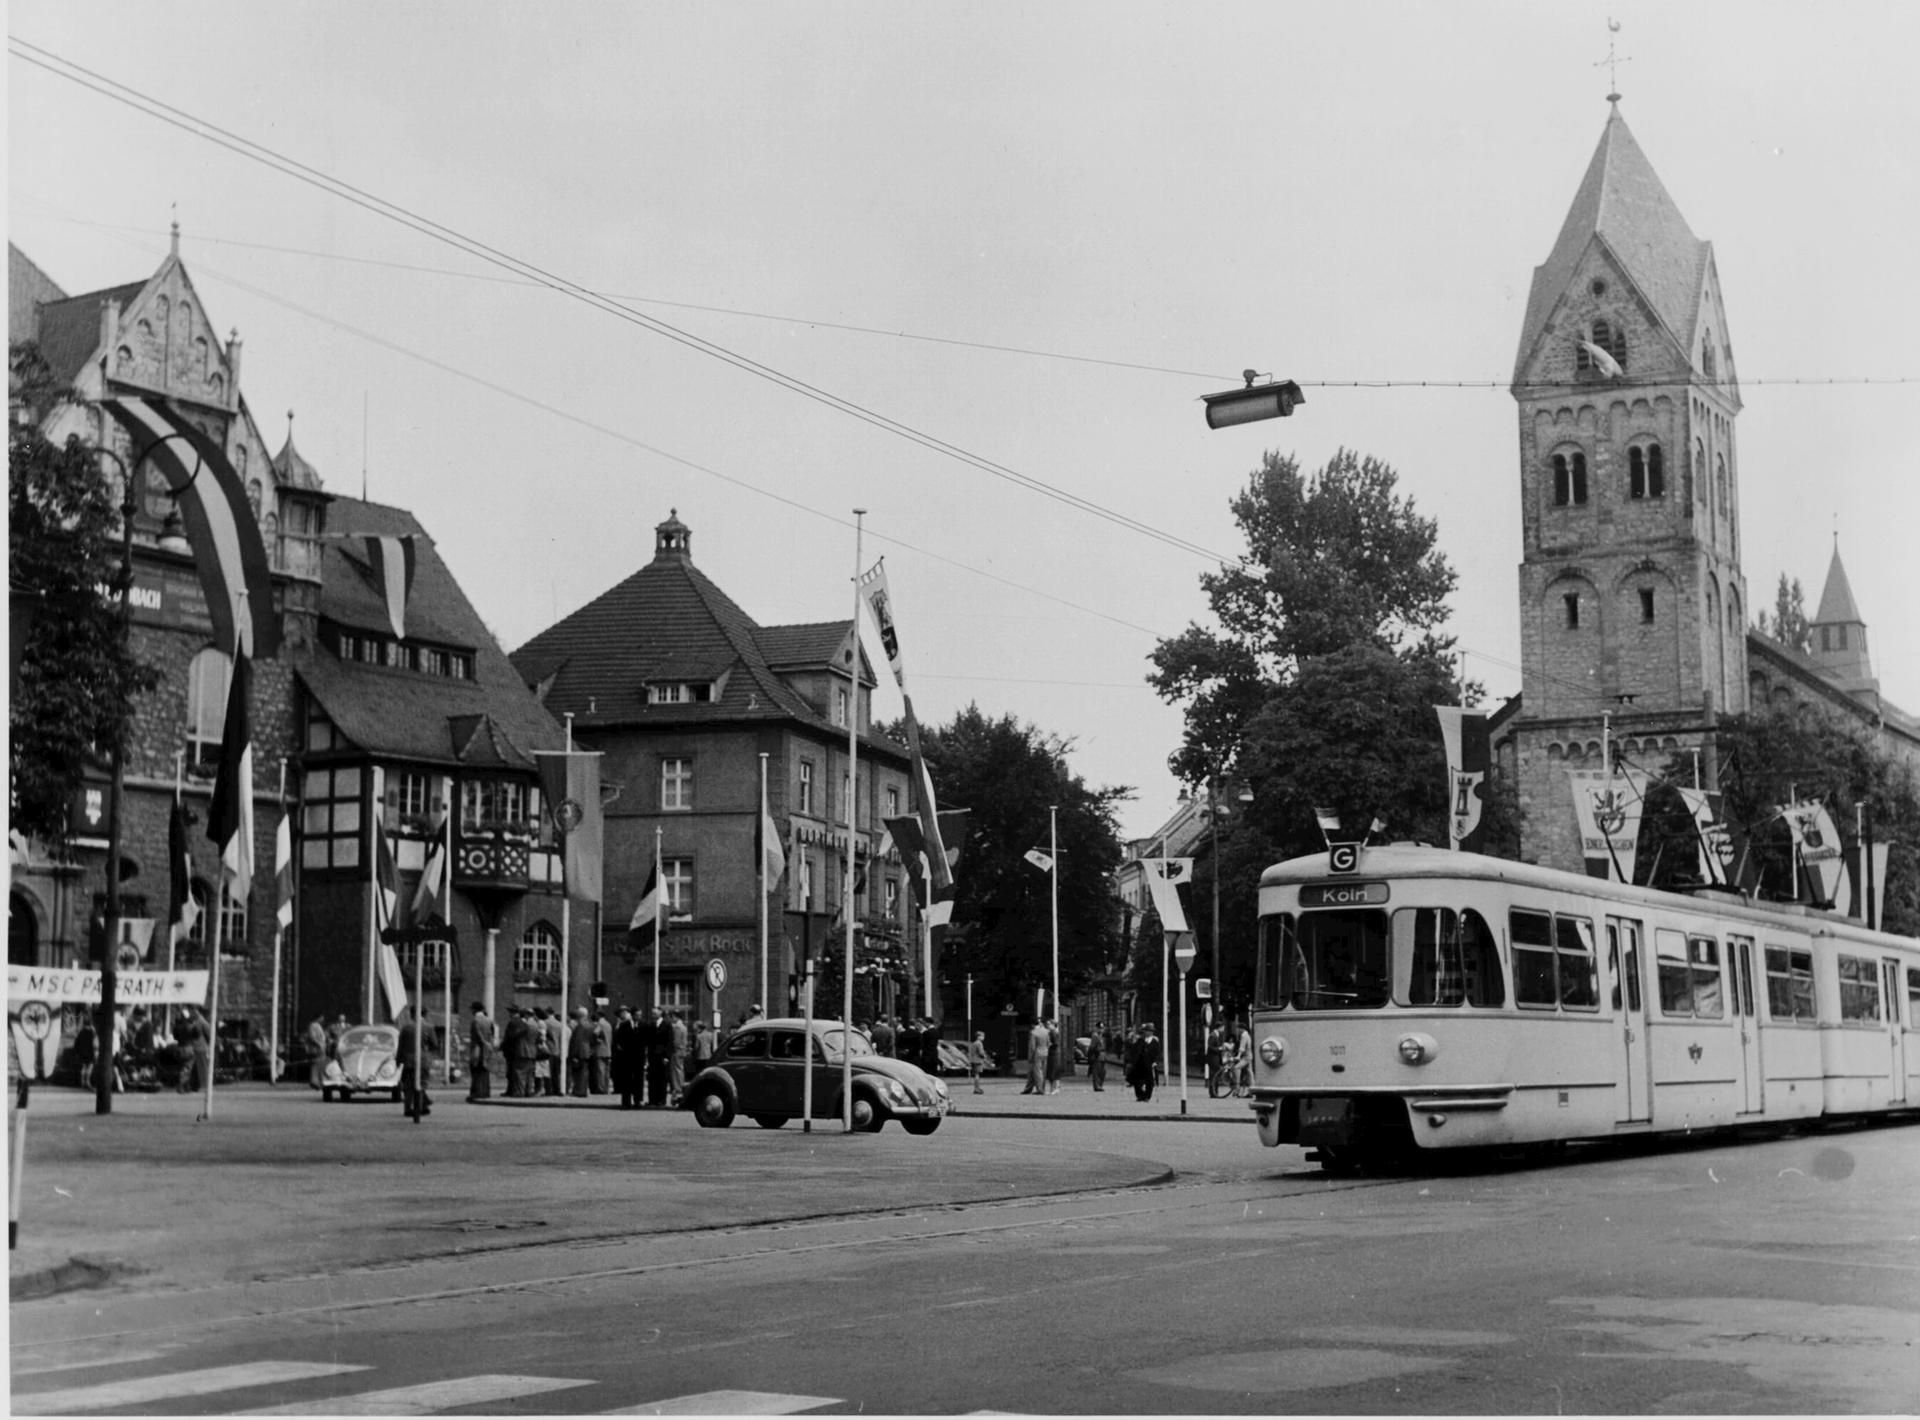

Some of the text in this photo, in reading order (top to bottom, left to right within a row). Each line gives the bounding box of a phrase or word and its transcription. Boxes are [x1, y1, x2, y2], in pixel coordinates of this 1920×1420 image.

[1333, 847, 1354, 869] G
[1322, 887, 1368, 903] Köln
[28, 974, 165, 996] MSC PAFRATH
